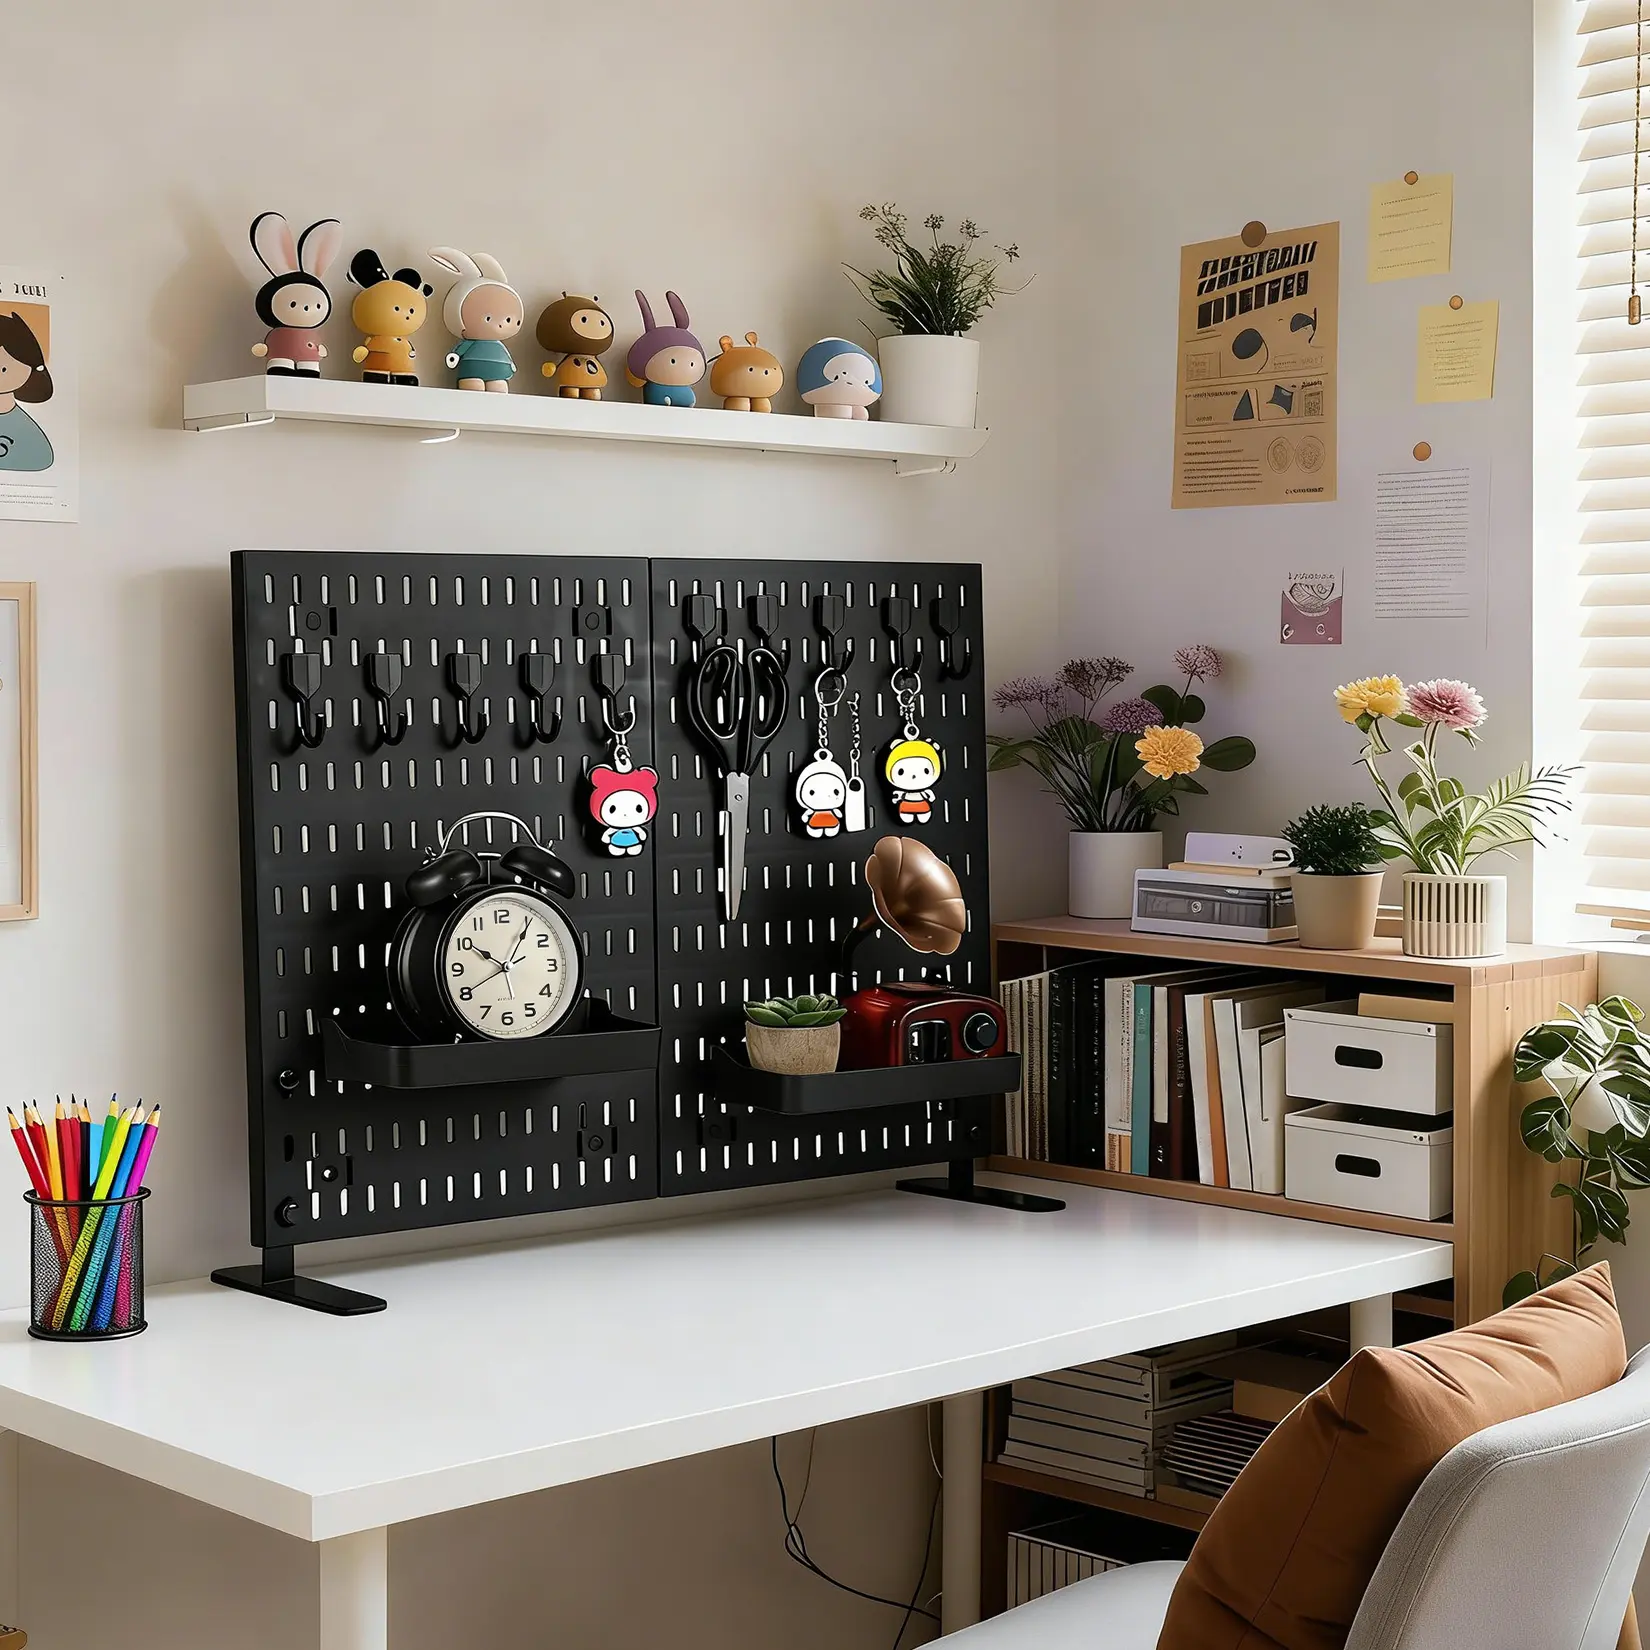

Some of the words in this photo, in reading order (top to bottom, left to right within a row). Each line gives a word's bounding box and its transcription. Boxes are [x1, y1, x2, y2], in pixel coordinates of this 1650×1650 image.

[494, 909, 510, 924] 12
[473, 917, 483, 931] 11
[457, 937, 473, 951] 10
[536, 934, 549, 948] 2
[451, 962, 464, 977] 9
[546, 958, 558, 972] 3
[460, 987, 473, 1001] 8
[539, 983, 552, 998] 4
[480, 1005, 492, 1019] 7
[524, 1003, 537, 1017] 5
[501, 1012, 514, 1026] 6
